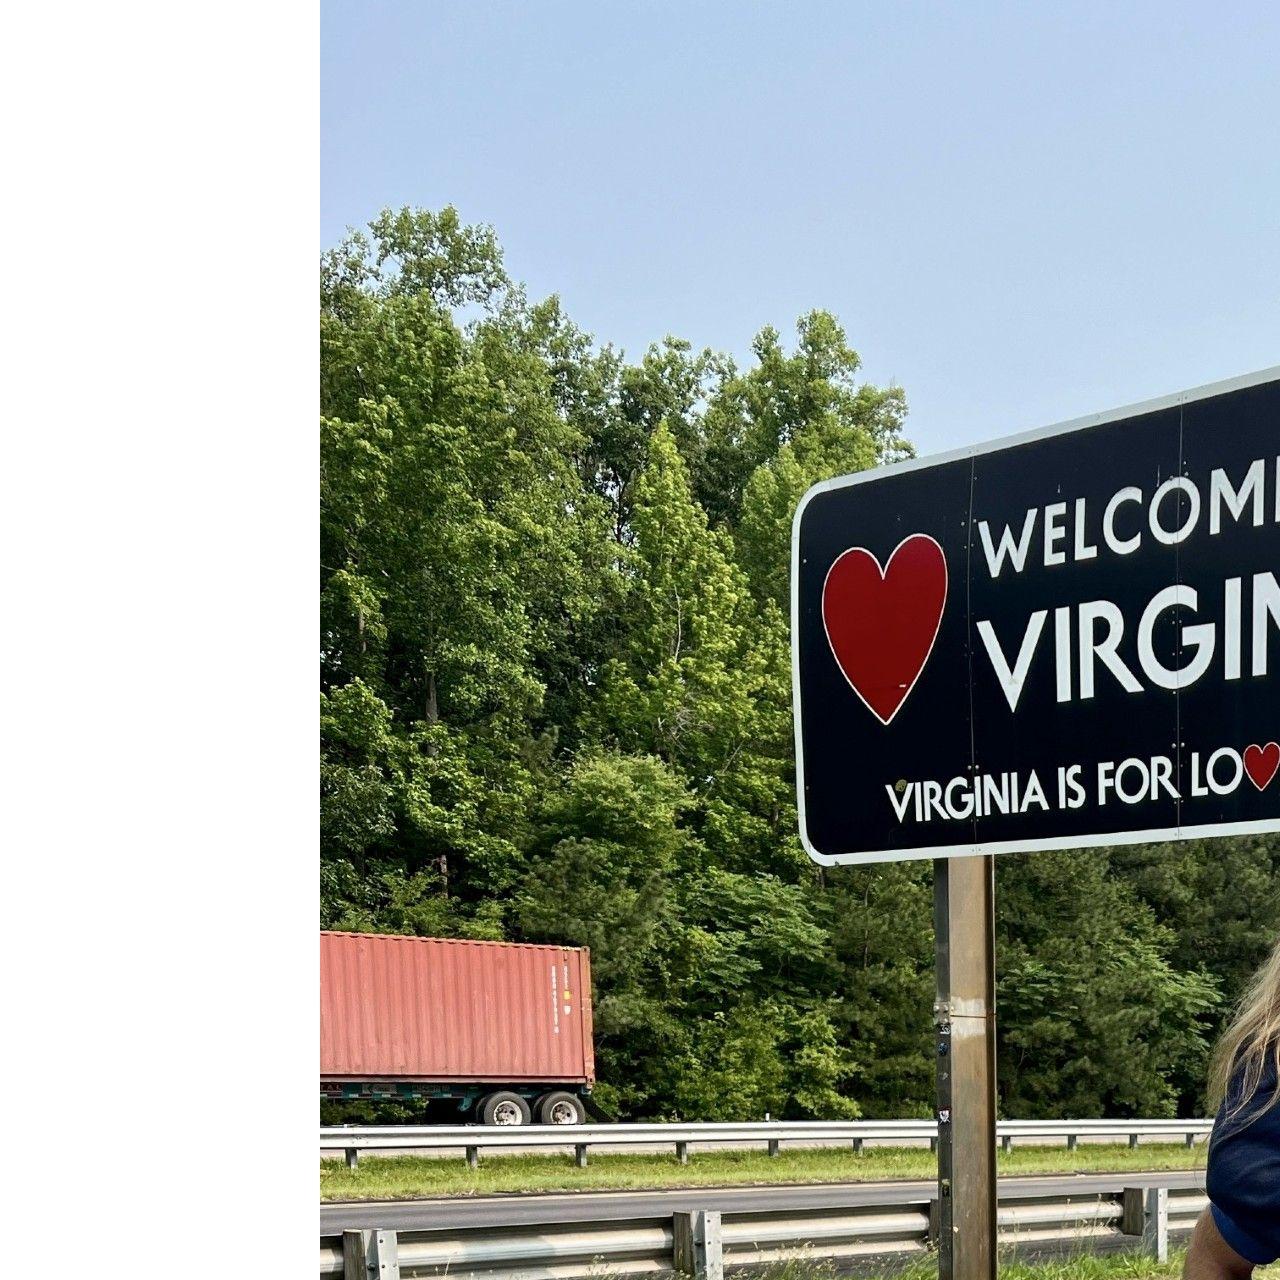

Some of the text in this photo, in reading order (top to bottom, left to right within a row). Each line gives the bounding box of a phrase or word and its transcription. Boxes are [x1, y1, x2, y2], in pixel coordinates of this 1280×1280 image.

[884, 768, 1050, 824] VIRGINIA
[1057, 764, 1086, 809] IS
[1097, 756, 1182, 806] FOR
